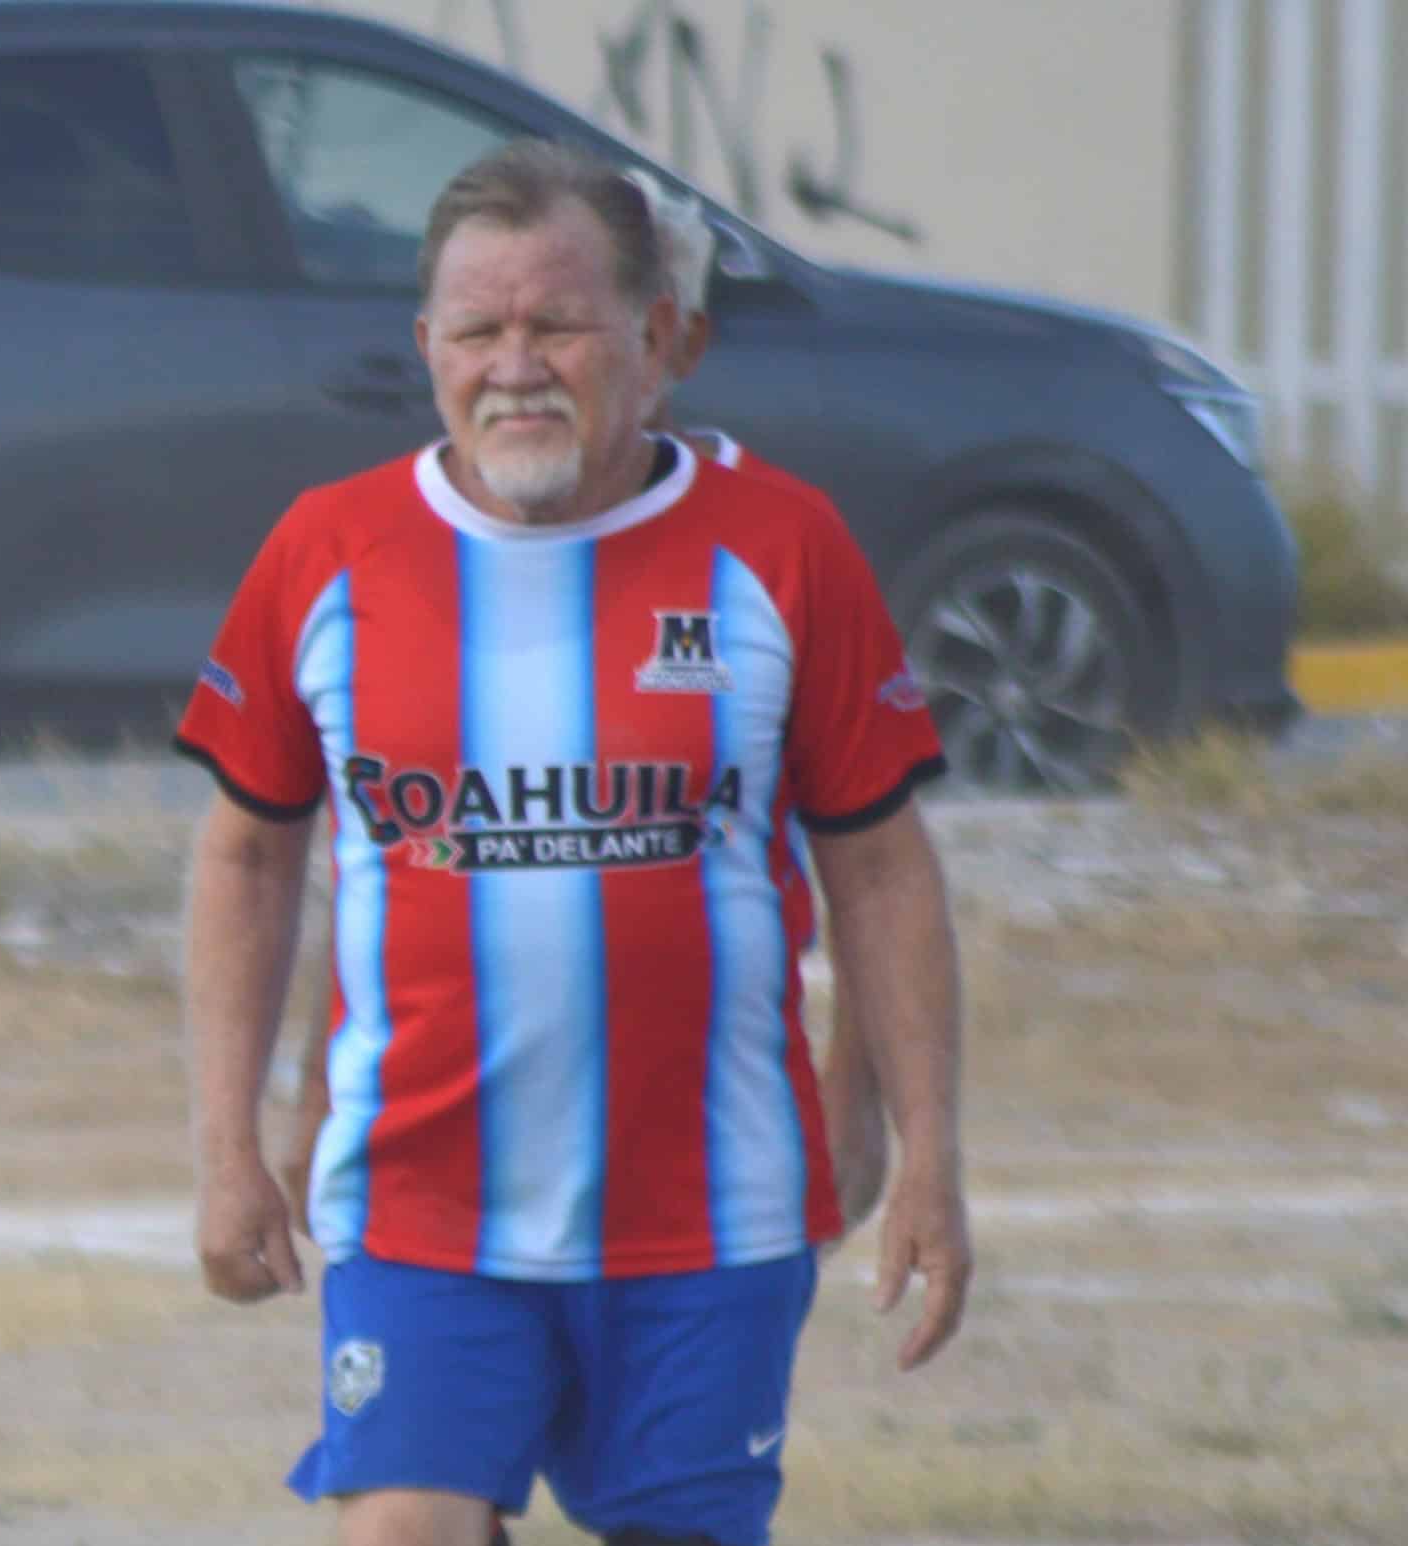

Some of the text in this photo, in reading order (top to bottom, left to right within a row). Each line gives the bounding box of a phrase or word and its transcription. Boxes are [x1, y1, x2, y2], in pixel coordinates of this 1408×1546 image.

[659, 614, 713, 661] M
[344, 757, 742, 845] COAHUILA
[533, 828, 680, 862] DELANTE
